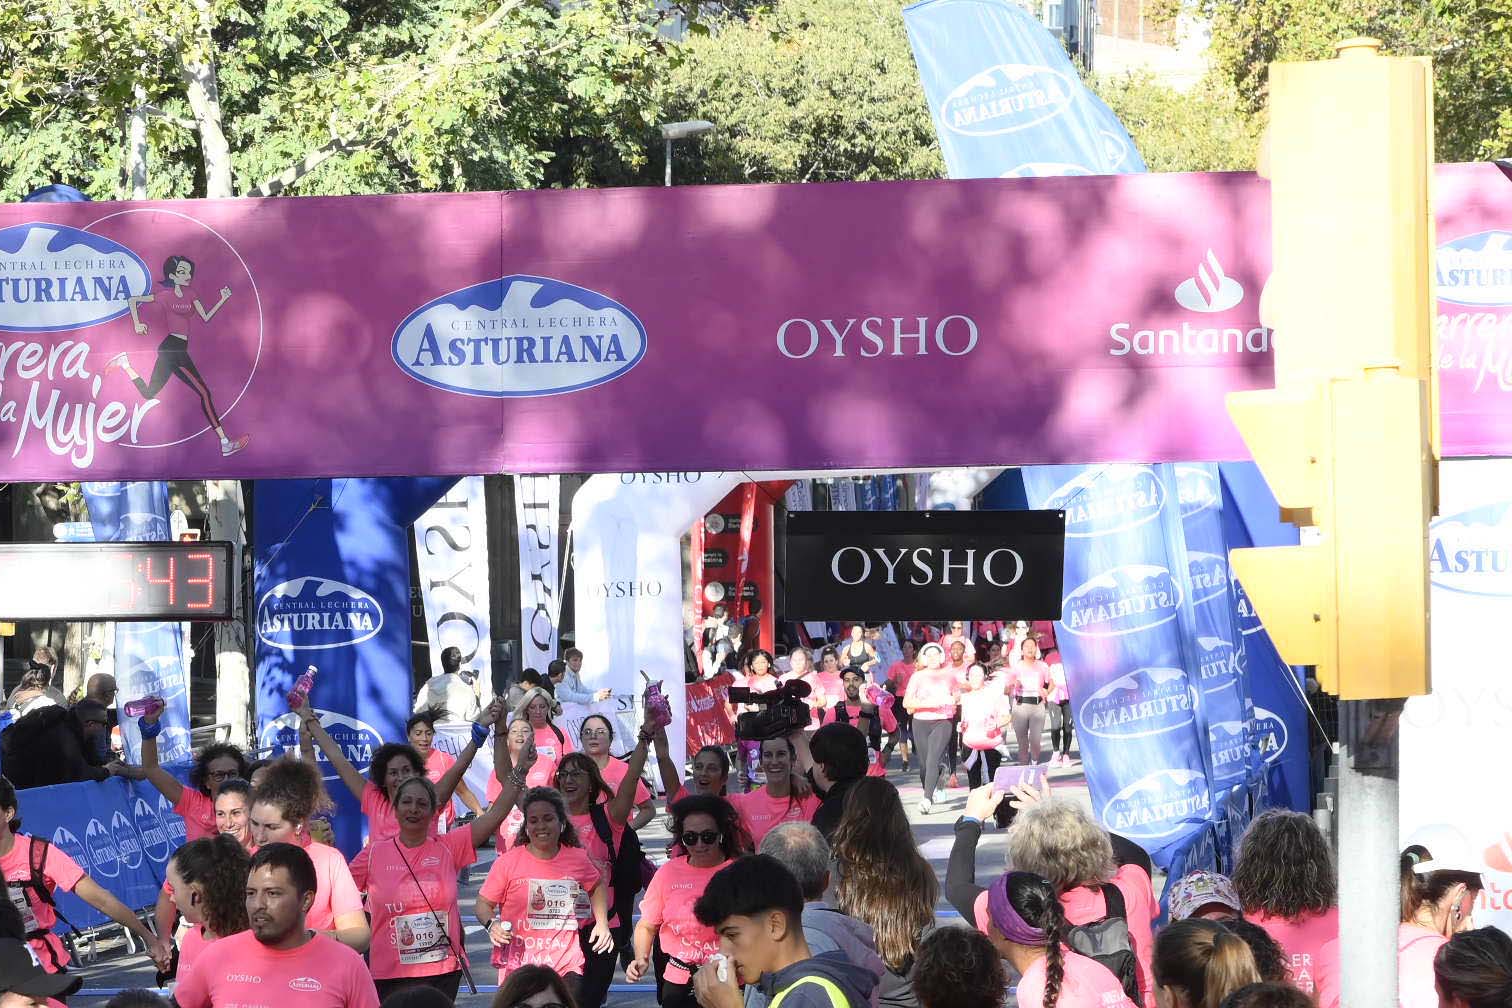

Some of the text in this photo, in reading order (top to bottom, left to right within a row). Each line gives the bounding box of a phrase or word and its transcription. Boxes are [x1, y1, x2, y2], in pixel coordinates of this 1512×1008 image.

[54, 258, 127, 271] LECHERA
[450, 316, 619, 331] CENTRAL LECHERA
[776, 313, 978, 357] OYSHO
[412, 322, 627, 368] ASTURIANA
[13, 378, 160, 468] Mujer
[831, 546, 1024, 587] OYSHO
[1430, 538, 1512, 574] ASTU
[587, 581, 662, 598] OYSHO
[320, 600, 369, 610] LECHERA
[261, 606, 374, 634] ASTURIANA
[227, 974, 262, 984] OYSHO
